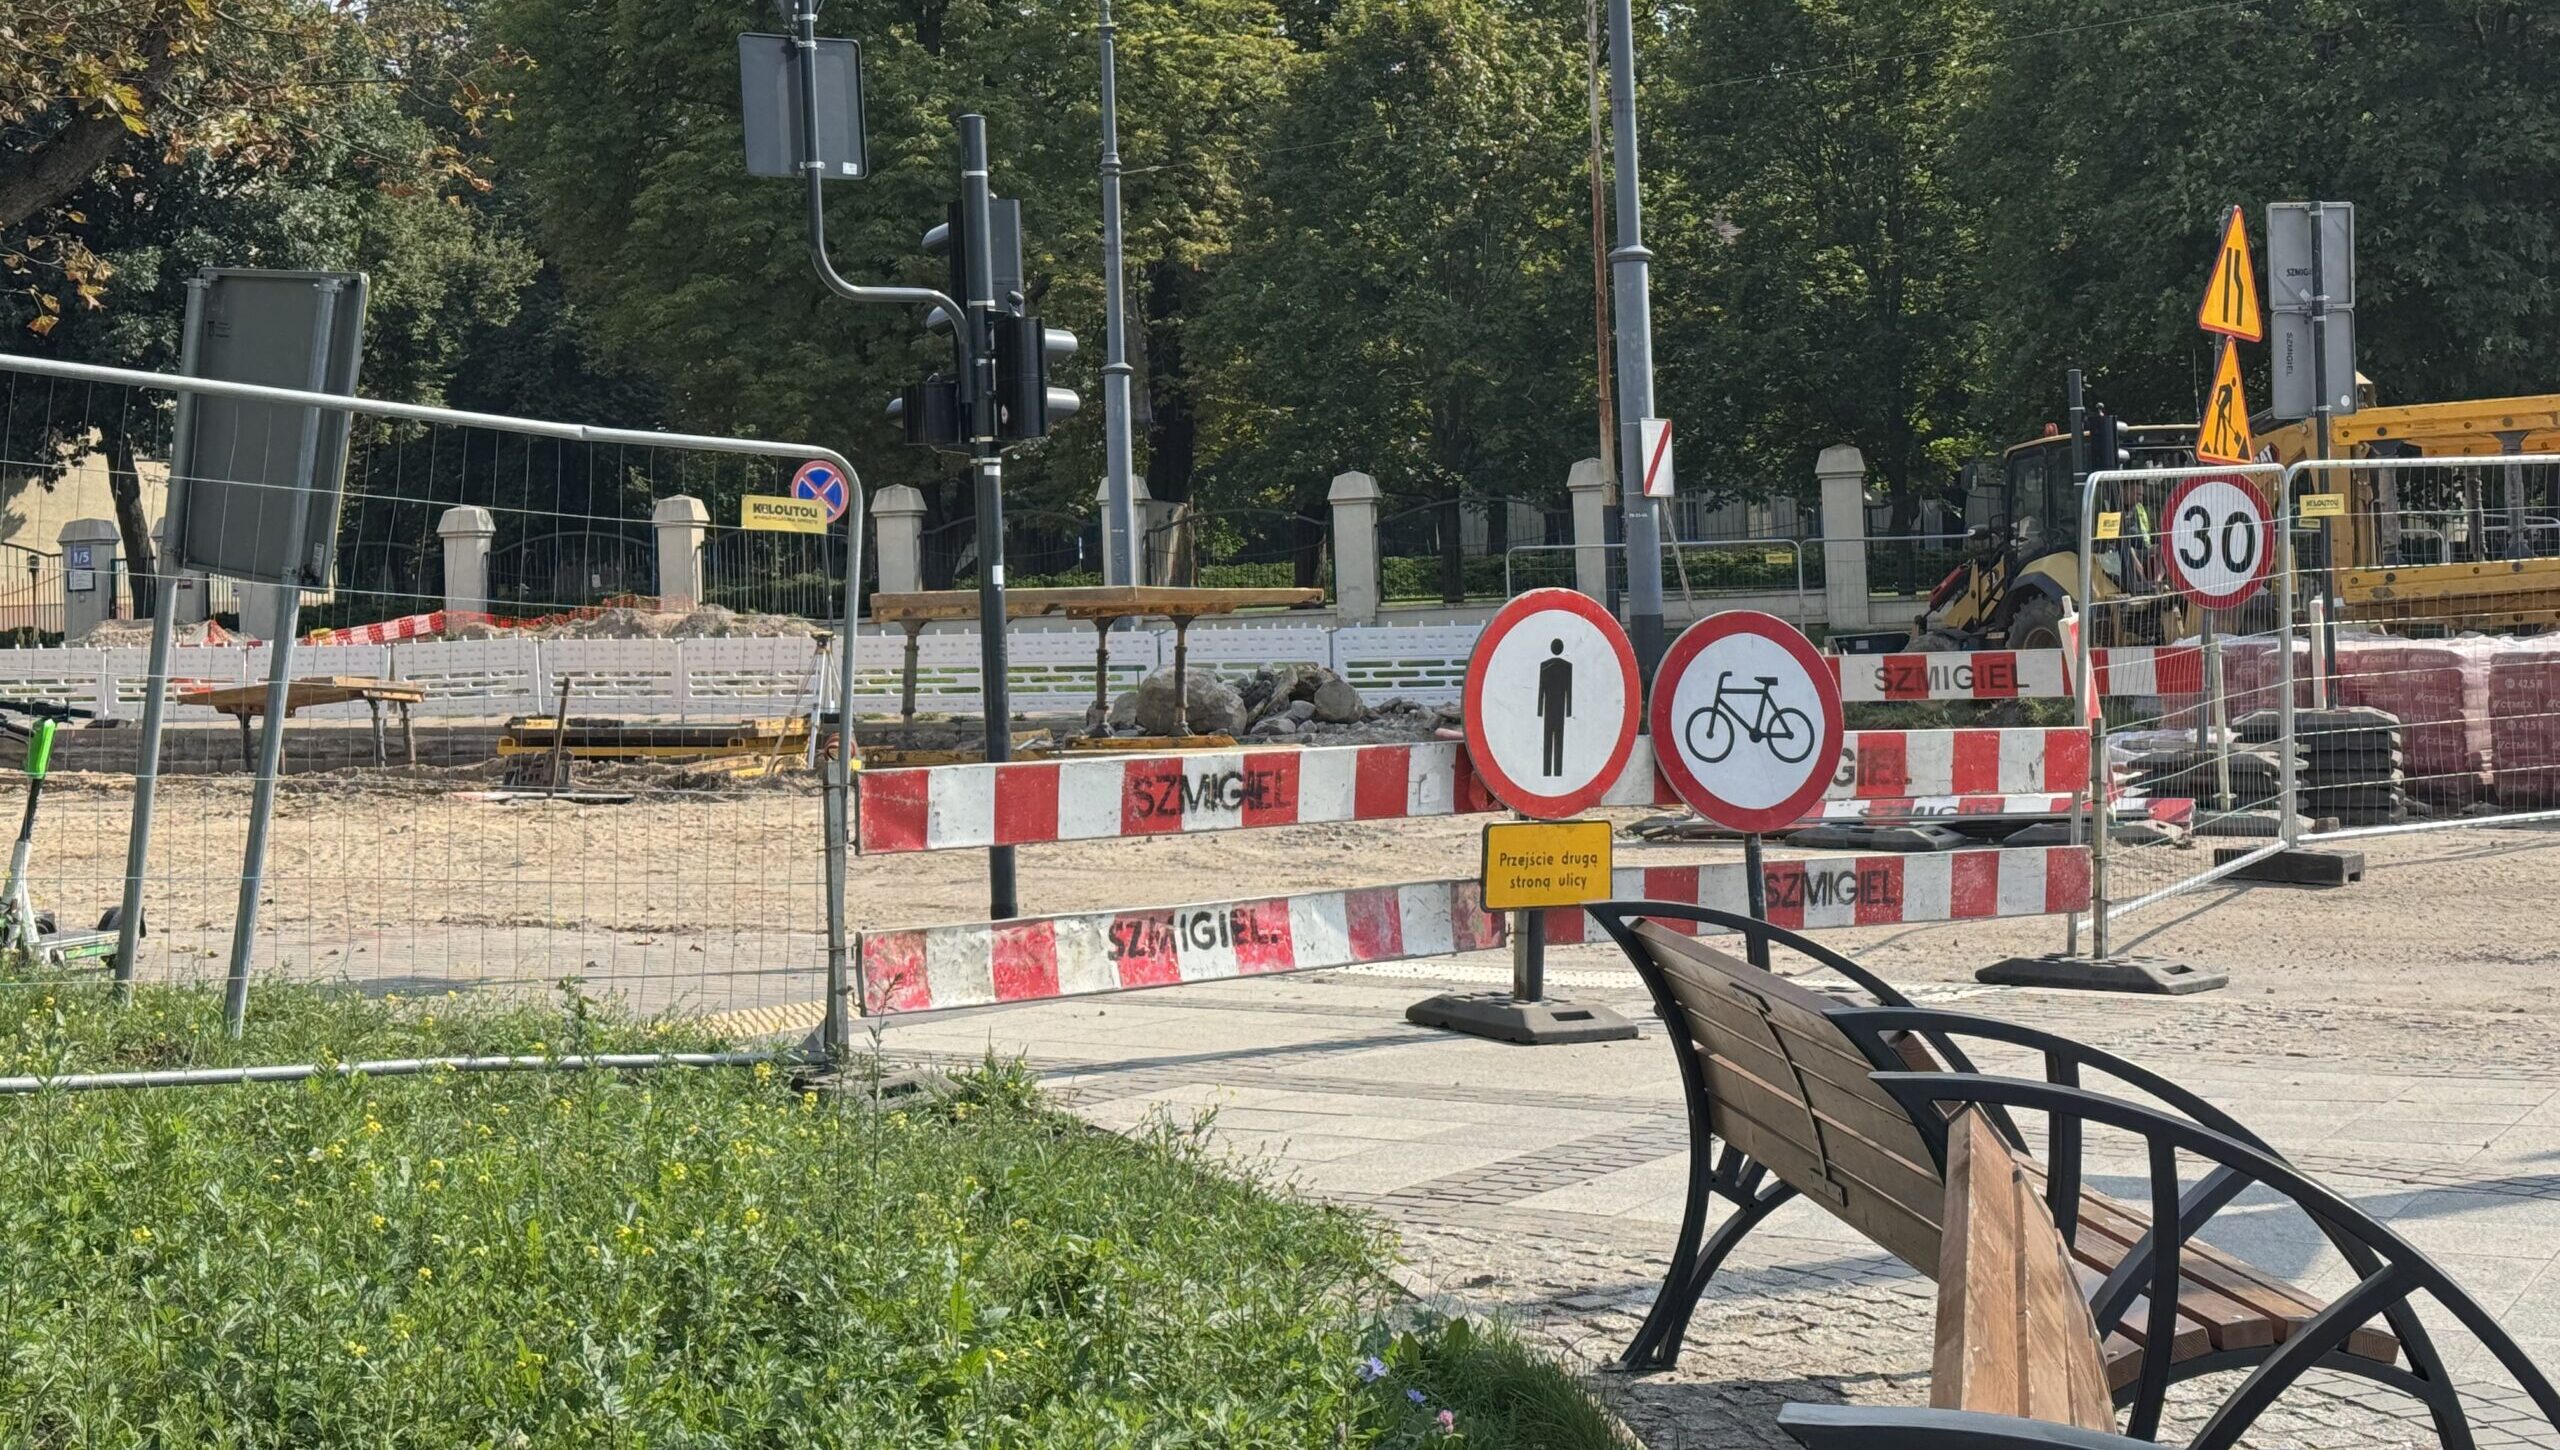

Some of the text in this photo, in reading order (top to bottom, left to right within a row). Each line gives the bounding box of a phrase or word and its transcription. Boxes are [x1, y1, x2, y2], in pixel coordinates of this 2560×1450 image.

[2179, 505, 2255, 573] 30
[74, 551, 90, 564] 1/5
[1874, 664, 2030, 692] SZMIGIEL
[2500, 700, 2533, 709] CEMEX
[1133, 769, 1292, 818] SZMIGIEL
[1500, 851, 1598, 870] Przejście drugą
[1509, 872, 1588, 892] stroną ulicy
[1765, 870, 1896, 908] SZMIGIEL
[1107, 908, 1278, 961] SZMIGIEL.
